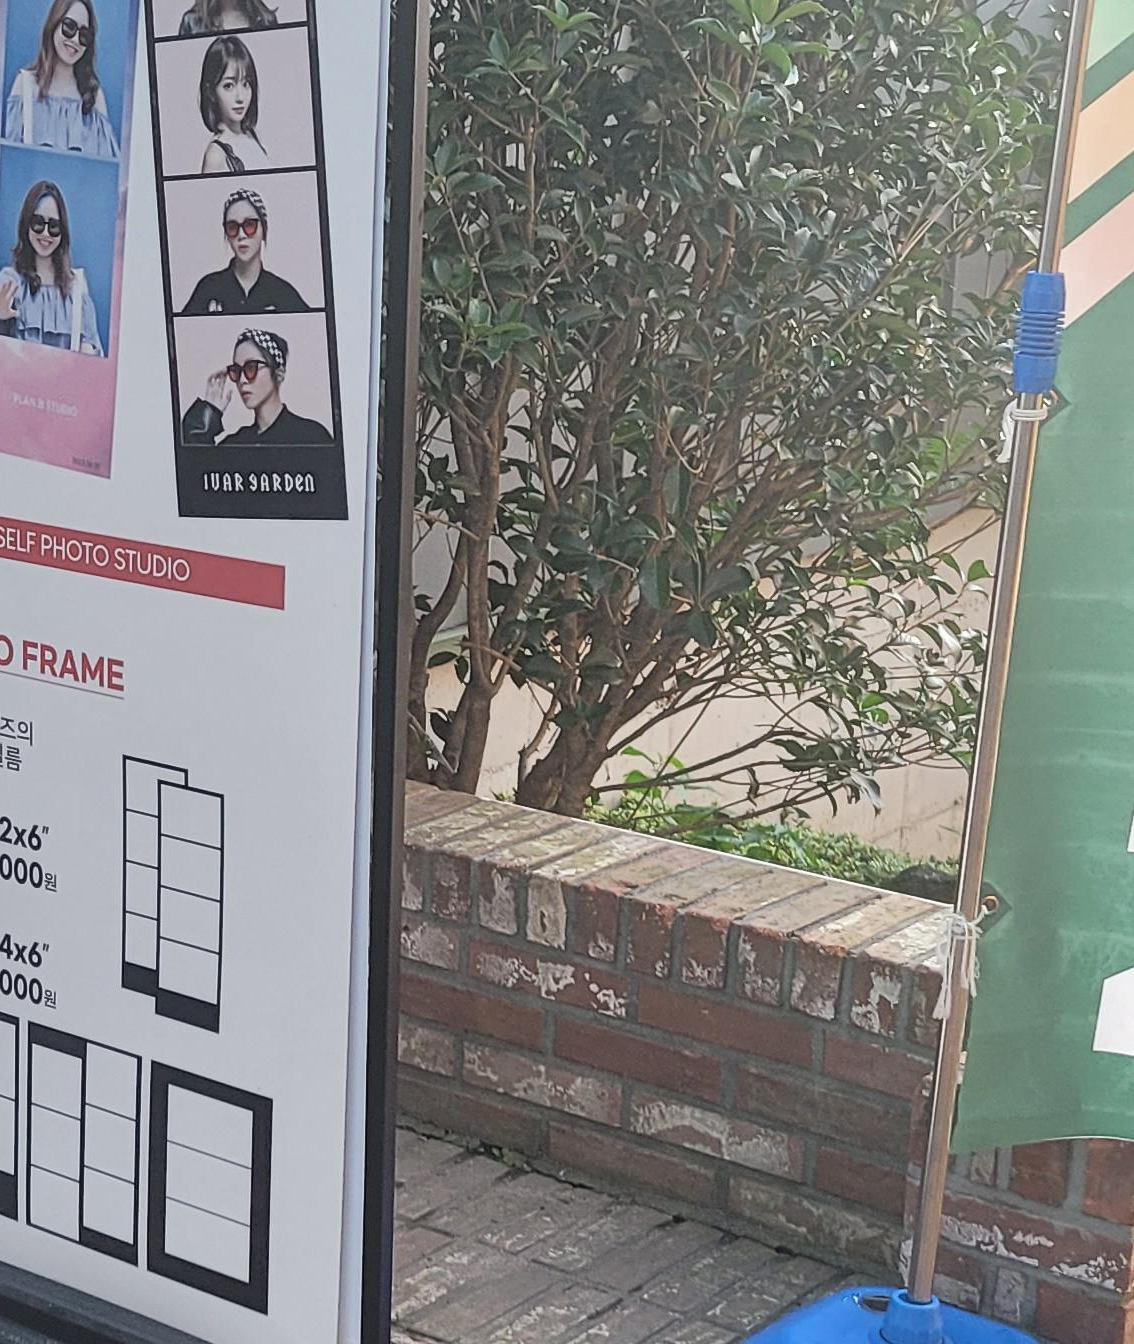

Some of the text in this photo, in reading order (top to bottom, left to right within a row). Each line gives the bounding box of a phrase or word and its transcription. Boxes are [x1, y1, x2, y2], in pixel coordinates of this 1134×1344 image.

[40, 533, 110, 568] PHOTO
[113, 547, 191, 582] STUDIO
[22, 639, 125, 692] FRAME
